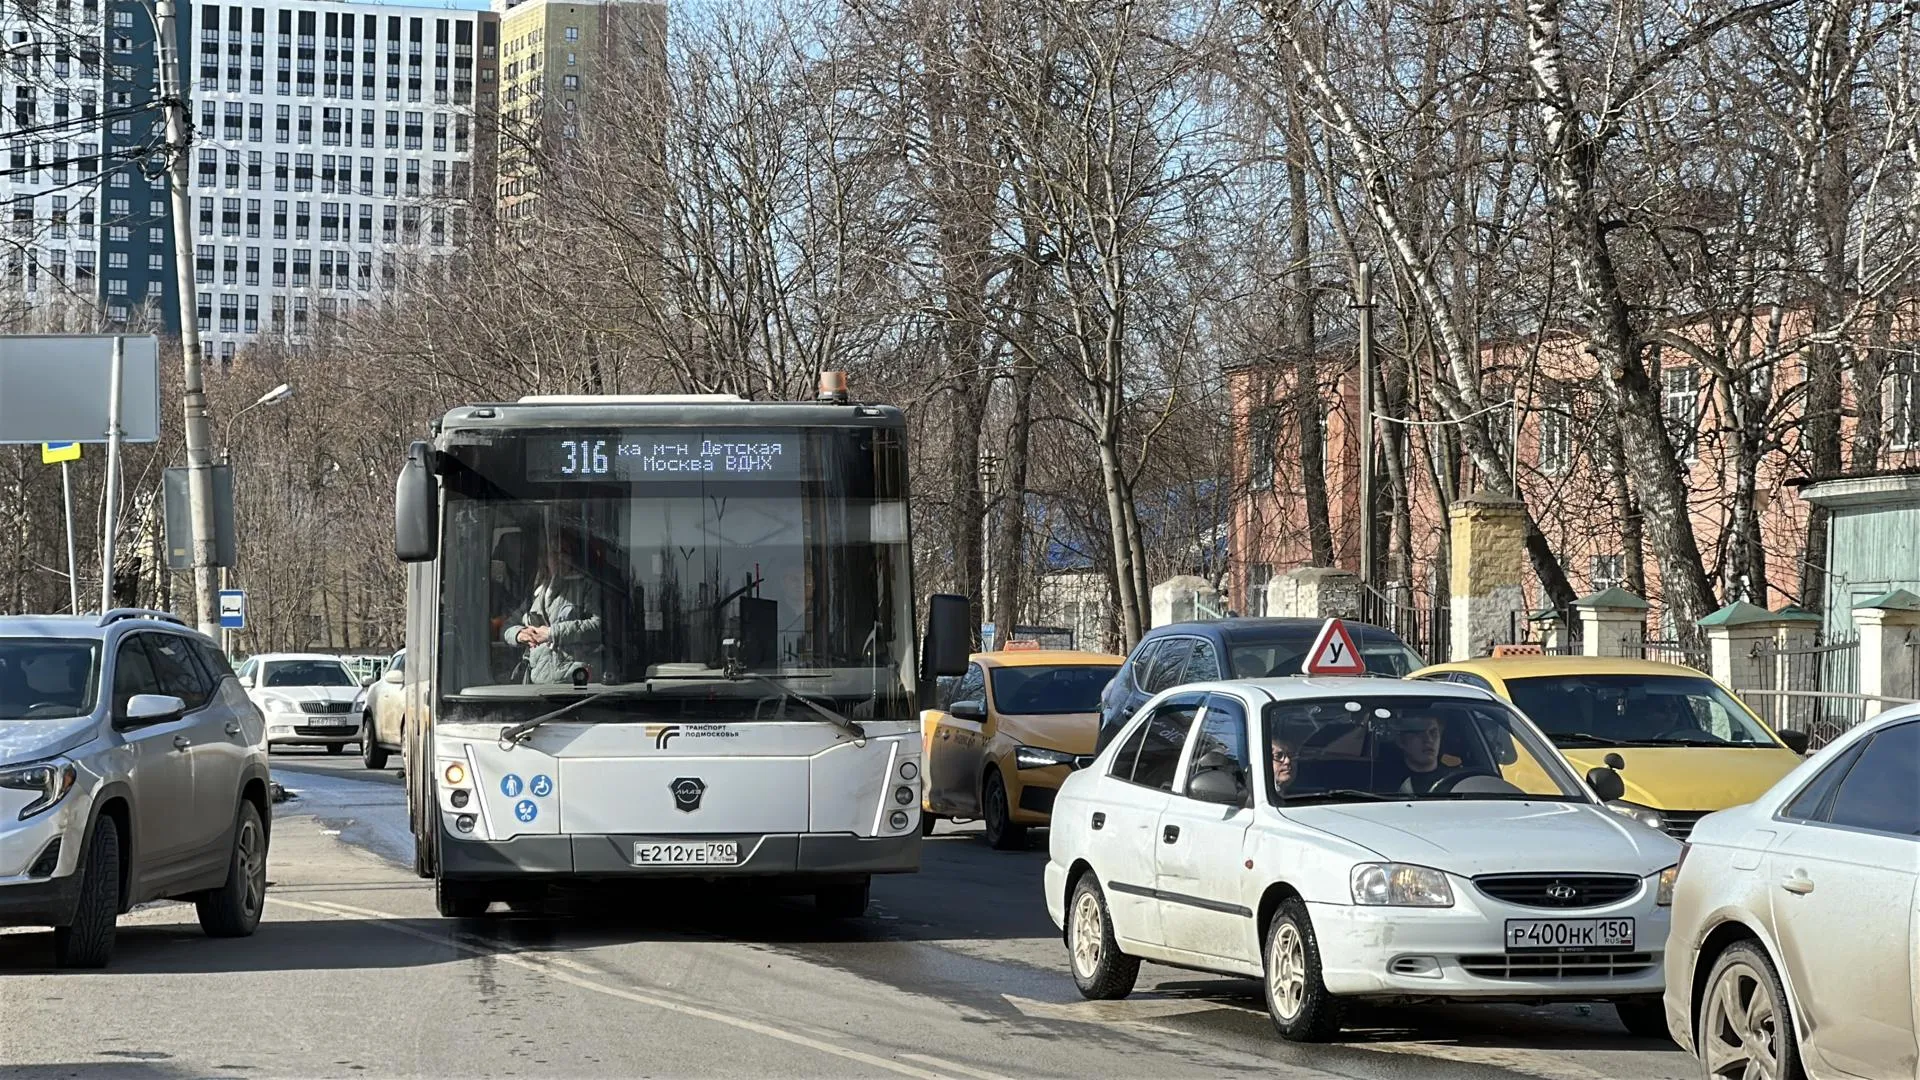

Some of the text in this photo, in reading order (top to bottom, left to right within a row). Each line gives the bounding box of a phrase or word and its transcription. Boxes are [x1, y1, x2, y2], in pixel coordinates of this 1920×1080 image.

[561, 440, 608, 474] 316
[618, 440, 782, 457] ка м-н Детская
[643, 455, 772, 473] Москва ВДНХ
[641, 844, 733, 862] Е212УЕ 790
[1514, 921, 1629, 945] Р400НК 150
[1604, 937, 1621, 945] RUS
